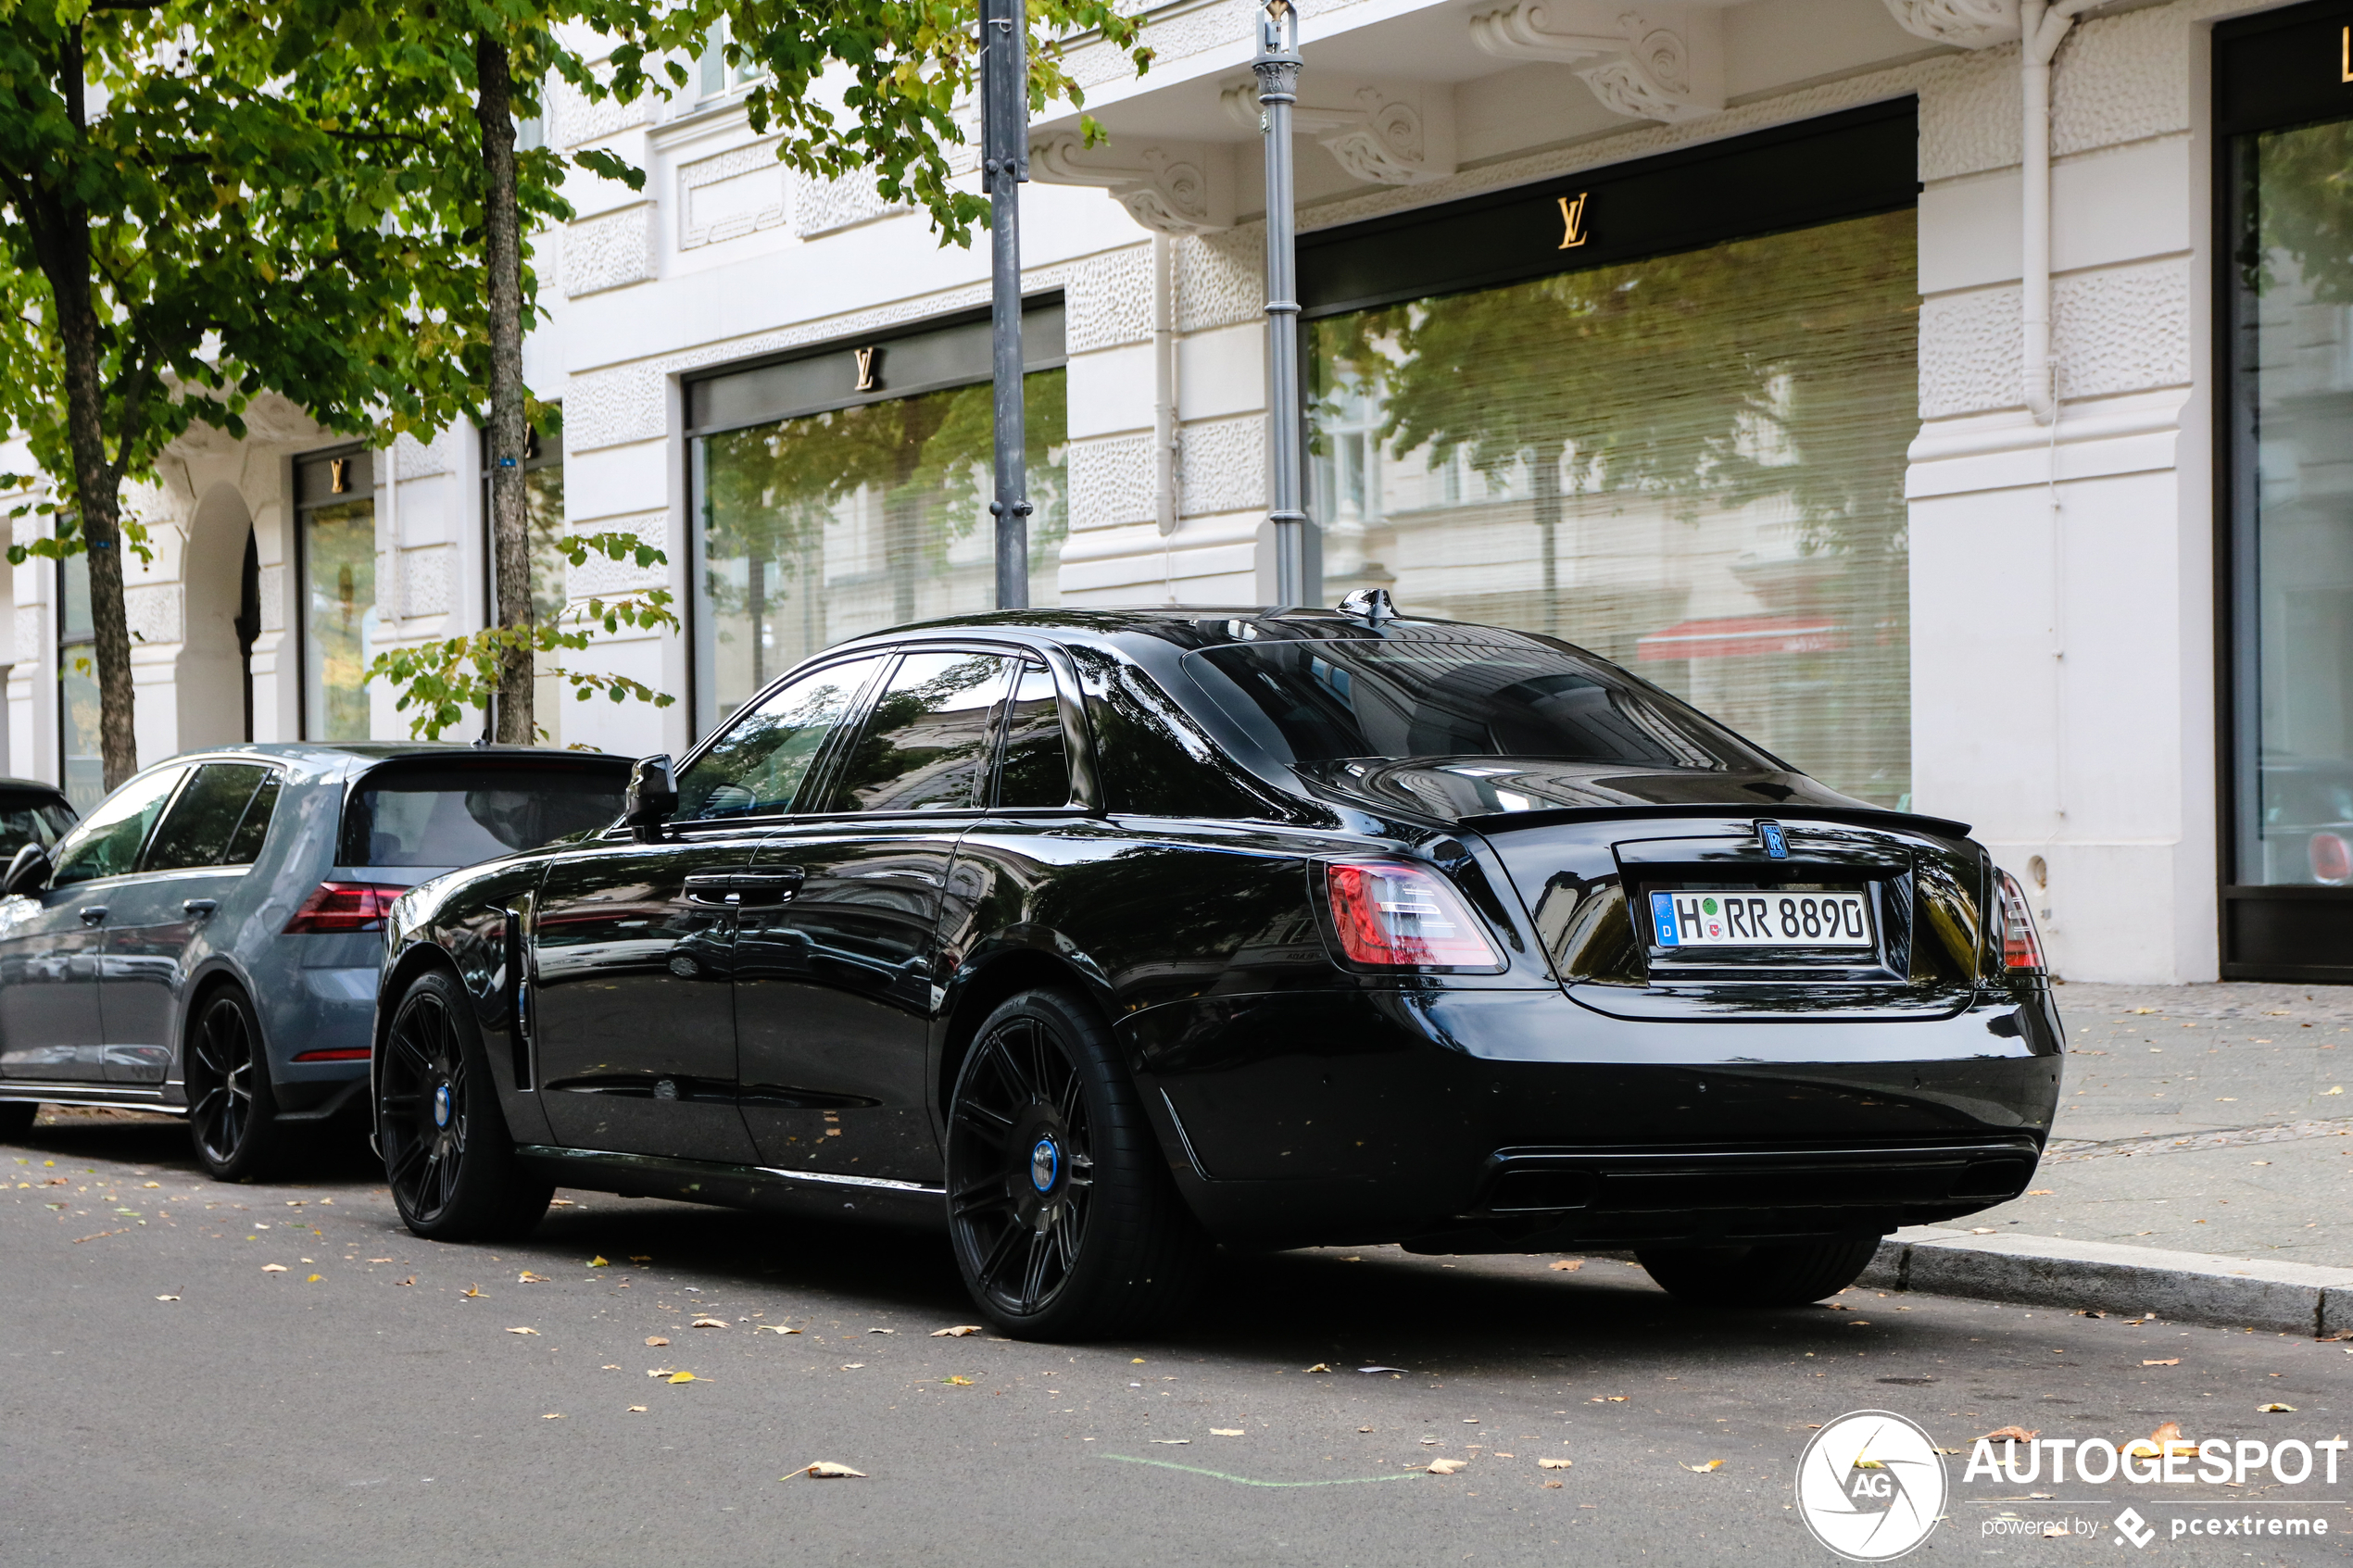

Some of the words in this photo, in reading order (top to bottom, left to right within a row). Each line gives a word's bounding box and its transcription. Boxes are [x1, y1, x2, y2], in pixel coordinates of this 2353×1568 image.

[1676, 898, 1703, 938] H
[1724, 898, 1772, 938] RR
[1779, 897, 1864, 938] 8890
[1662, 925, 1672, 937] D
